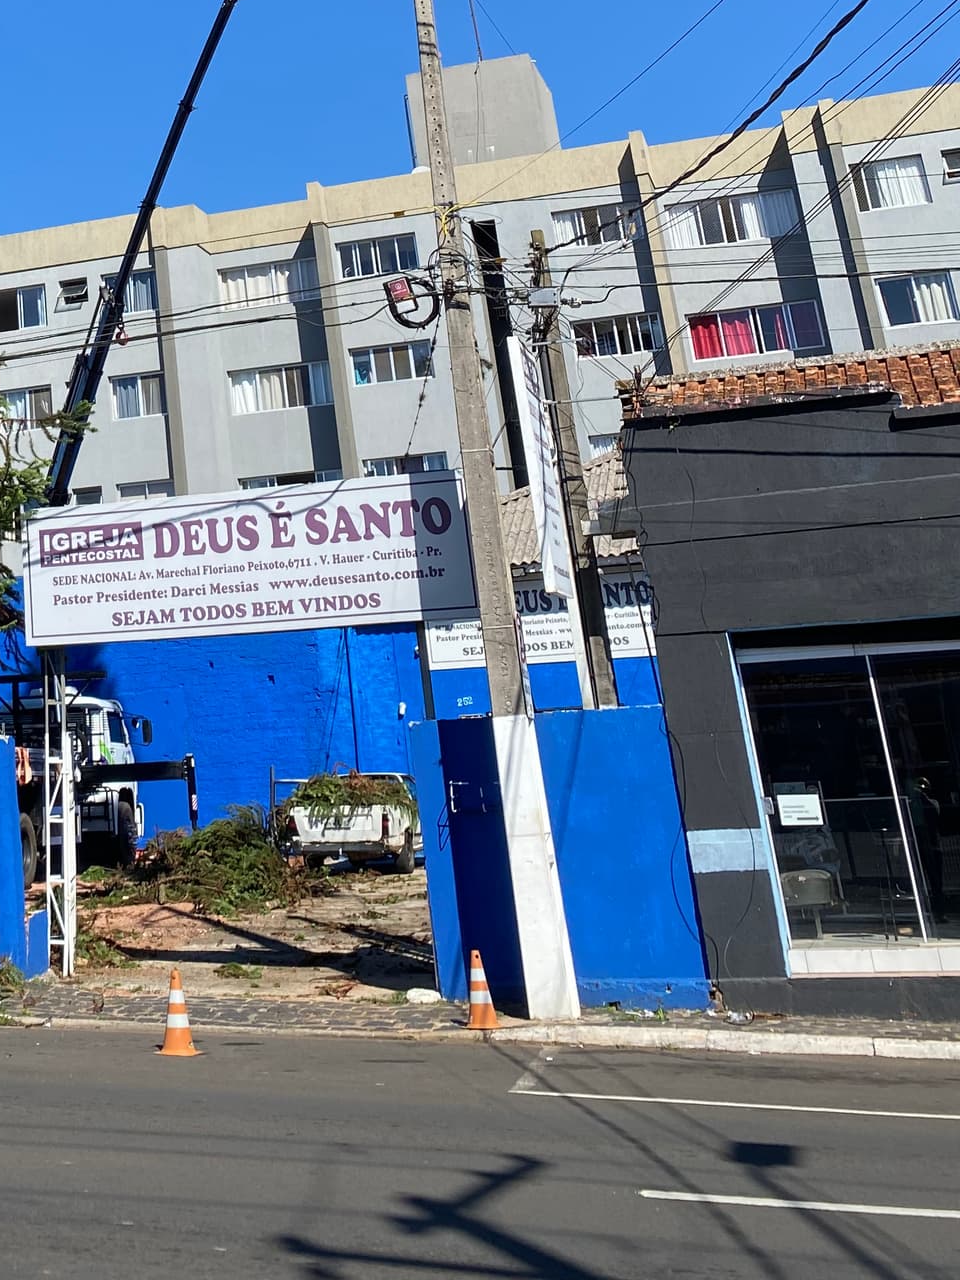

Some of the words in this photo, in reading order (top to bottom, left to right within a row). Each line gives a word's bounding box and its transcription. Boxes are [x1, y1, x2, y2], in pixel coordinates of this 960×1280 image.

[43, 527, 139, 552] IGREJA
[152, 515, 259, 558] DEUS
[268, 501, 295, 548] É
[305, 496, 451, 545] SANTO
[44, 549, 140, 565] PENTECOSTAL
[53, 575, 78, 586] SEDE
[80, 571, 136, 584] NACIONAL:
[139, 570, 154, 580] Av.
[156, 566, 200, 579] Marechal
[203, 563, 245, 575] Floriano
[332, 553, 365, 564] Hauer
[373, 548, 417, 561] Curitiba
[426, 546, 442, 557] Pr.
[53, 594, 93, 606] Pastor
[96, 588, 168, 603] Presidente:
[171, 584, 206, 598] Darci
[210, 581, 259, 595] Messias
[269, 566, 445, 590] www.deusesanto.com.br
[112, 608, 175, 626] SEJAM
[180, 603, 247, 622] TODOS
[252, 600, 294, 617] BEM
[298, 593, 381, 613] VINDOS
